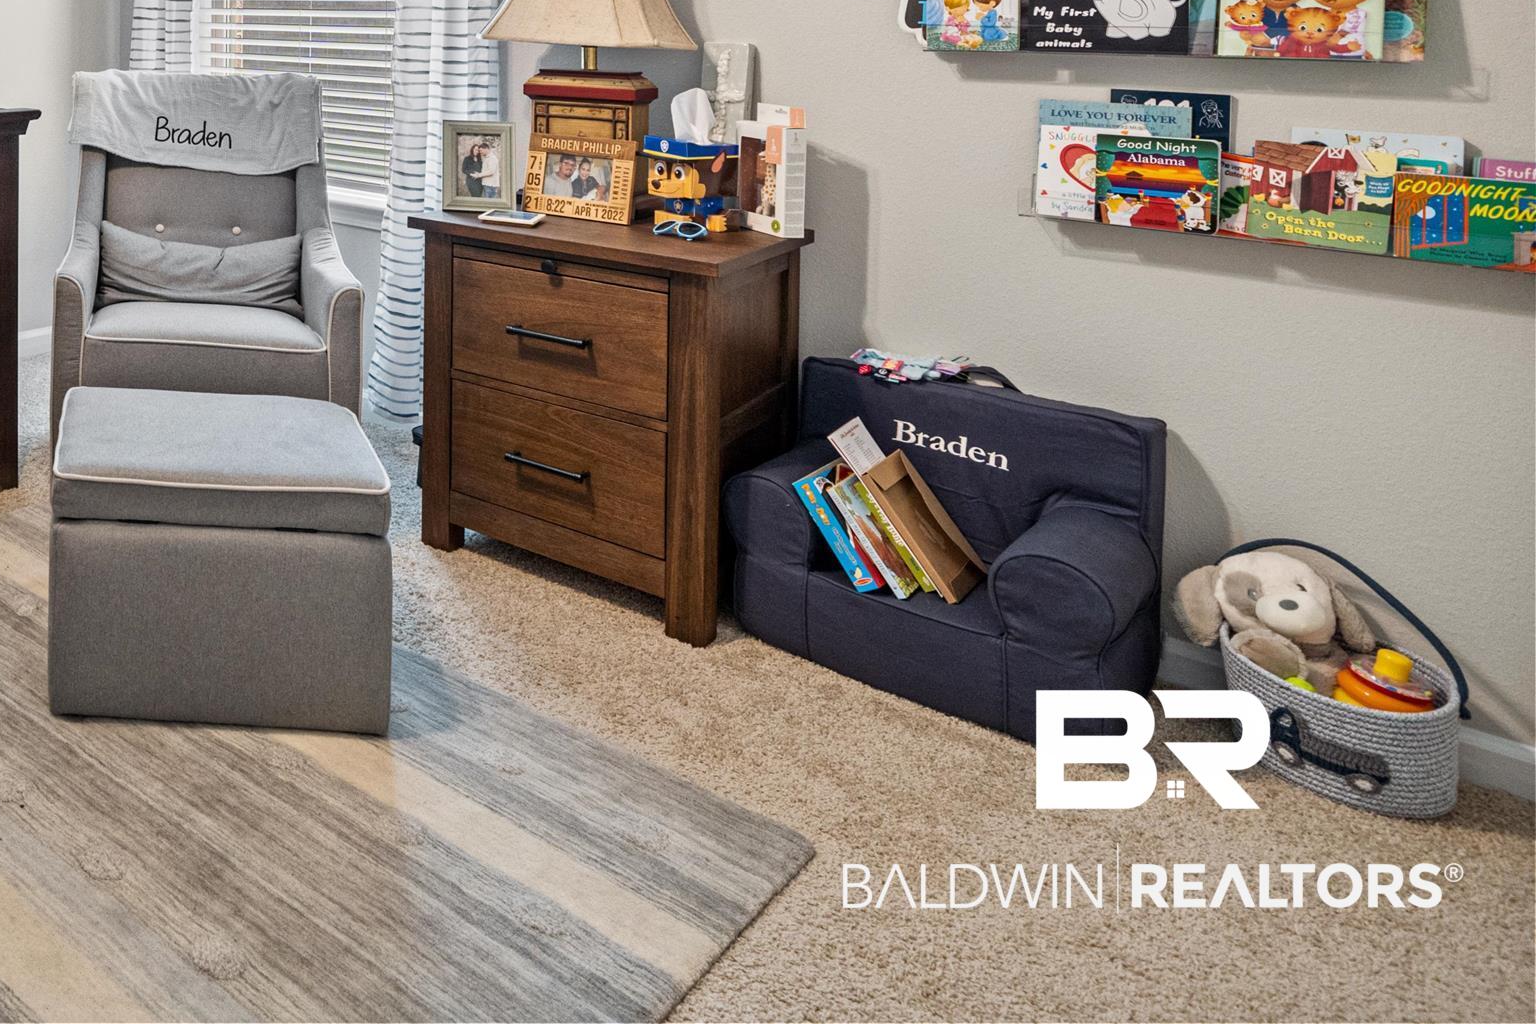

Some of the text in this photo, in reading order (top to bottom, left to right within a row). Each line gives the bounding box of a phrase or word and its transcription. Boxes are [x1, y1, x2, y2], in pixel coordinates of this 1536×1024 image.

[1033, 6, 1097, 19] My First
[1045, 22, 1083, 36] Baby
[1035, 39, 1093, 48] animals
[1050, 108, 1083, 119] LOVE
[1086, 110, 1113, 120] YOU
[1116, 112, 1177, 125] FOREVER
[154, 115, 233, 150] Braden
[541, 137, 622, 155] BRADEN PHILLIP
[1116, 138, 1197, 154] Good Night
[530, 155, 537, 169] 7
[1127, 153, 1186, 167] Alabama
[527, 172, 541, 186] 05
[1397, 178, 1527, 202] GOODNIGHT
[546, 198, 565, 214] 8:22
[575, 206, 591, 217] APR
[601, 208, 624, 222] 2022
[1265, 210, 1335, 229] Open the
[1283, 223, 1322, 238] Barn
[892, 418, 1011, 473] Braden
